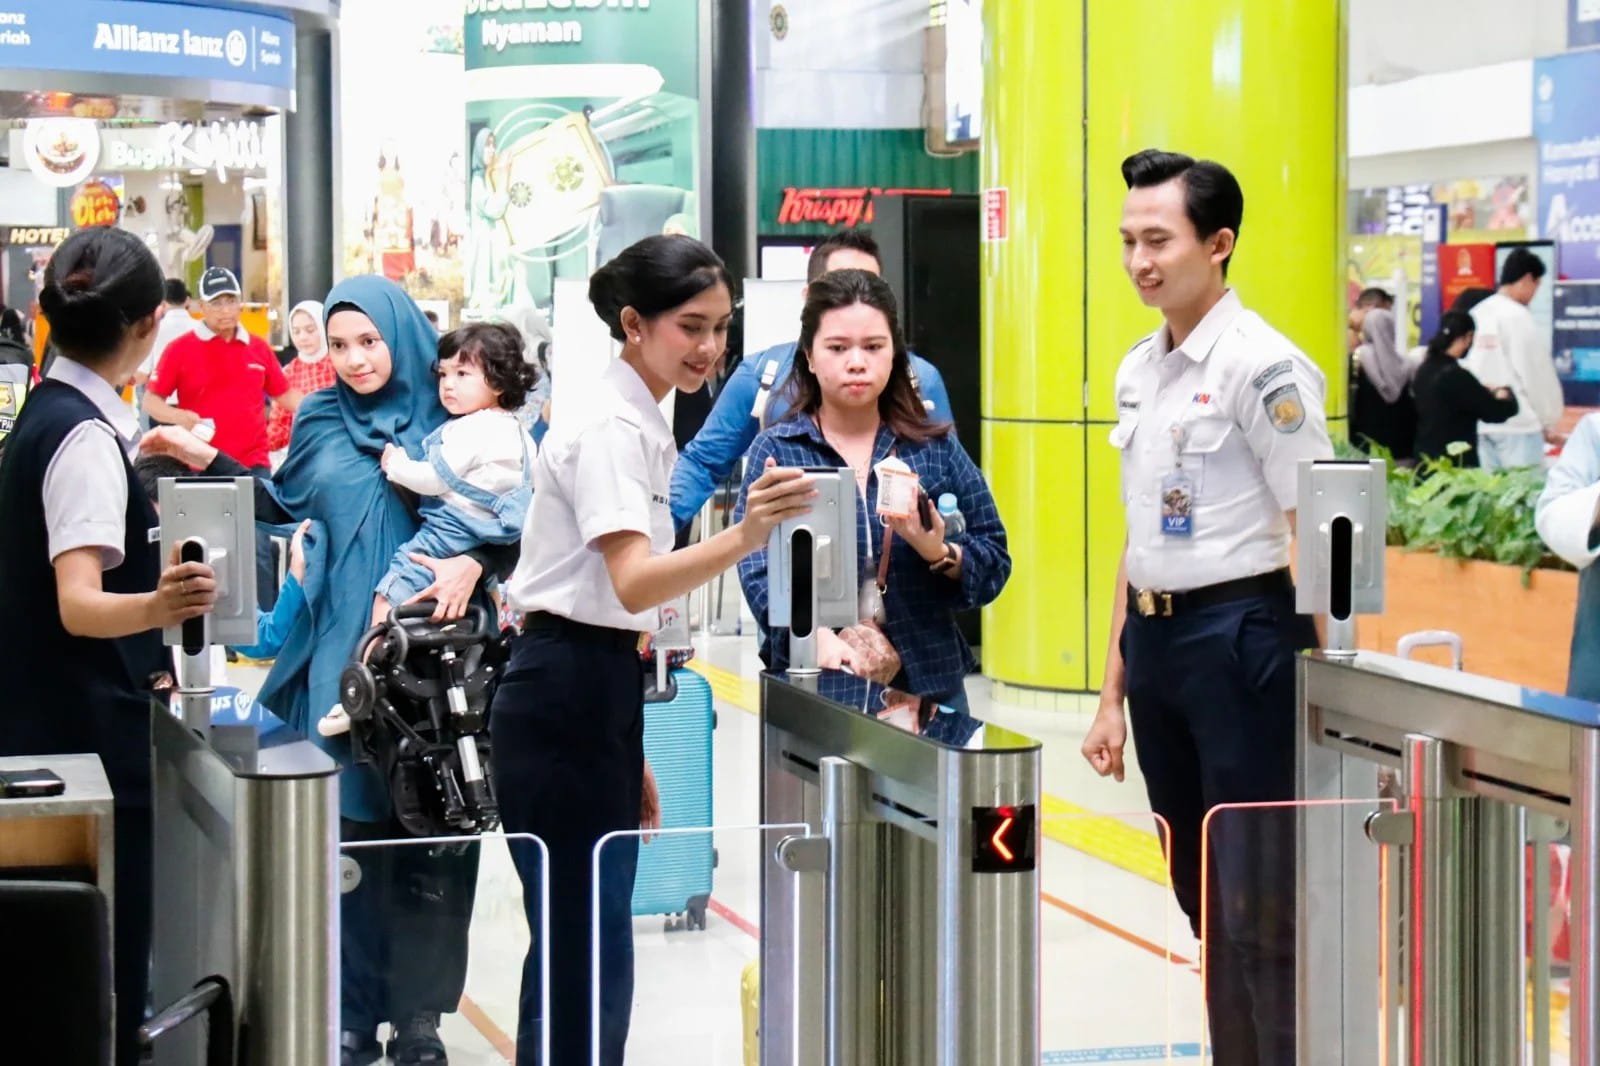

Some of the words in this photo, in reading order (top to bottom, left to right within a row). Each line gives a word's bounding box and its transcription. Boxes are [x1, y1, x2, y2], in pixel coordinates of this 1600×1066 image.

[93, 23, 180, 55] Allianz
[482, 19, 582, 51] Nyaman
[778, 187, 868, 227] Krispy
[1167, 516, 1186, 527] VIP
